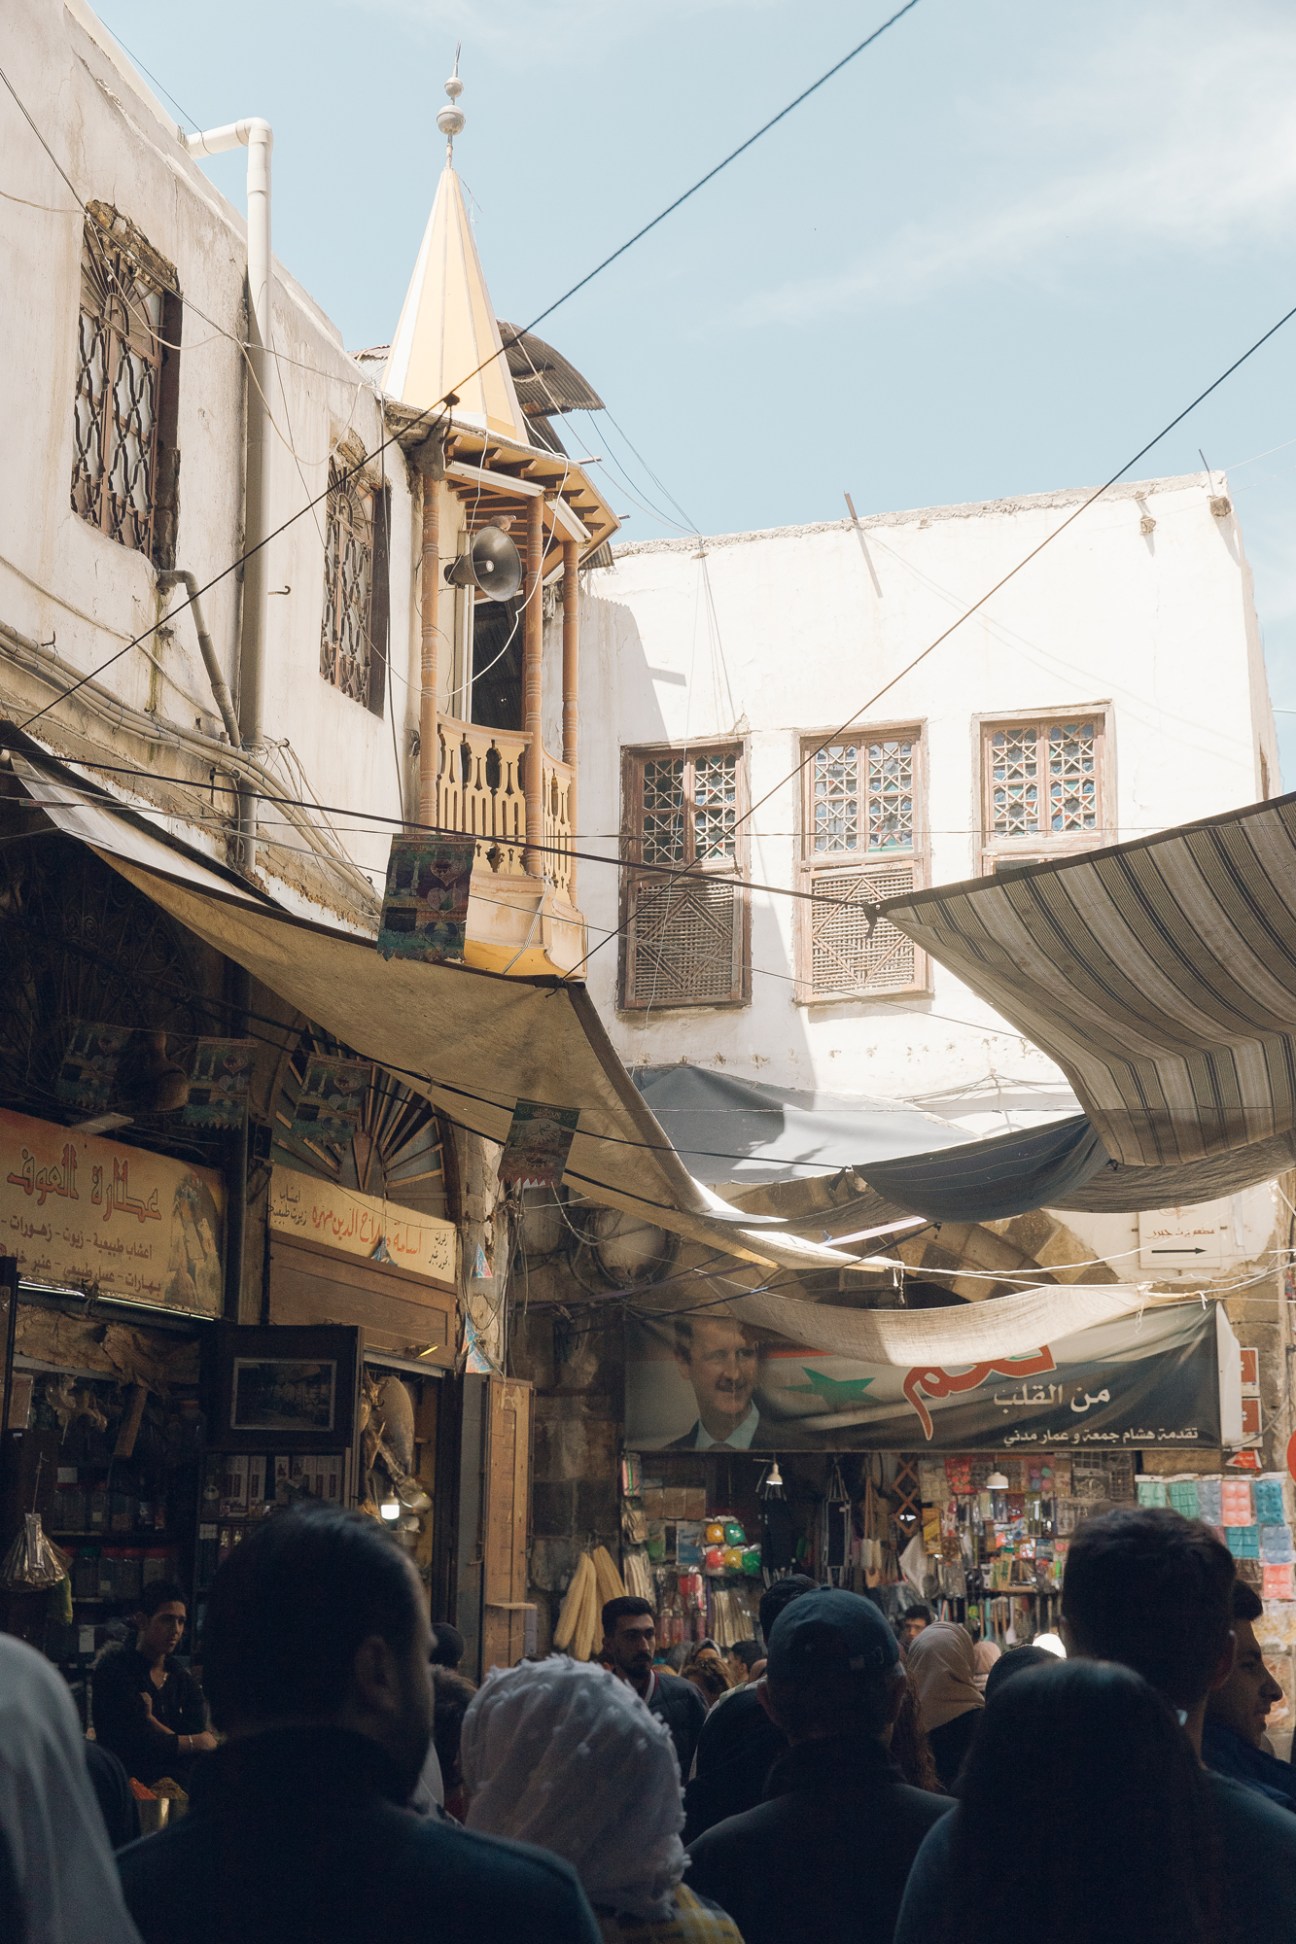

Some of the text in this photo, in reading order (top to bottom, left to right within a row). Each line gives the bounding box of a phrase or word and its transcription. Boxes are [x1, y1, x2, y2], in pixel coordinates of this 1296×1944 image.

[91, 1157, 162, 1223] عطارة
[993, 1383, 1111, 1414] من القلب
[1003, 1428, 1199, 1447] تقدمة هشام جمعة و عمار مدني
